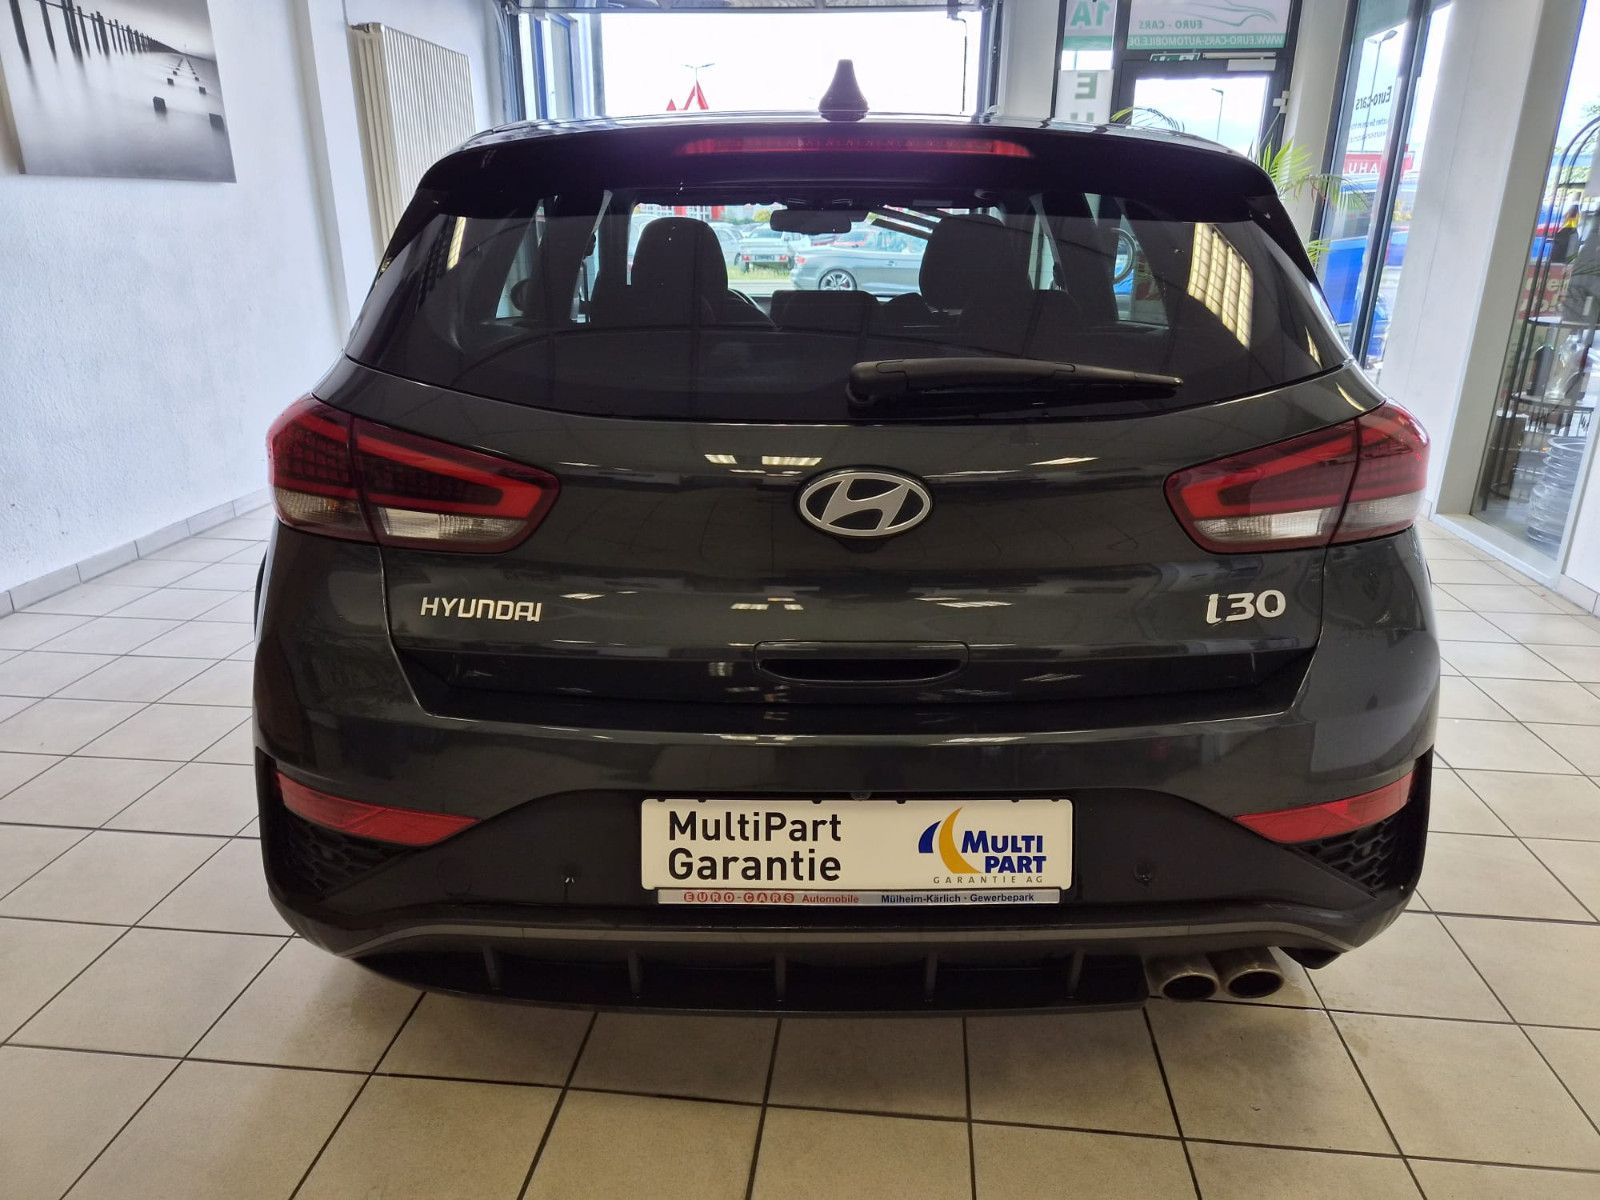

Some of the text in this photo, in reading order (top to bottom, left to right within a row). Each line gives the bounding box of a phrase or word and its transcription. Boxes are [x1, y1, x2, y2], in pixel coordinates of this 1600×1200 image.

[420, 596, 542, 622] HYUNDAI
[1206, 589, 1287, 624] i30
[669, 810, 842, 842] MultiPart
[961, 830, 1044, 854] MULTI
[668, 847, 842, 882] Garantie
[984, 855, 1047, 874] PART
[932, 875, 1044, 885] GARANTIE AG
[683, 891, 795, 904] EURO-CARS
[801, 893, 860, 904] Automobile
[881, 893, 961, 904] Mülheim-Kärlich
[969, 893, 1035, 904] Gewerbepark
